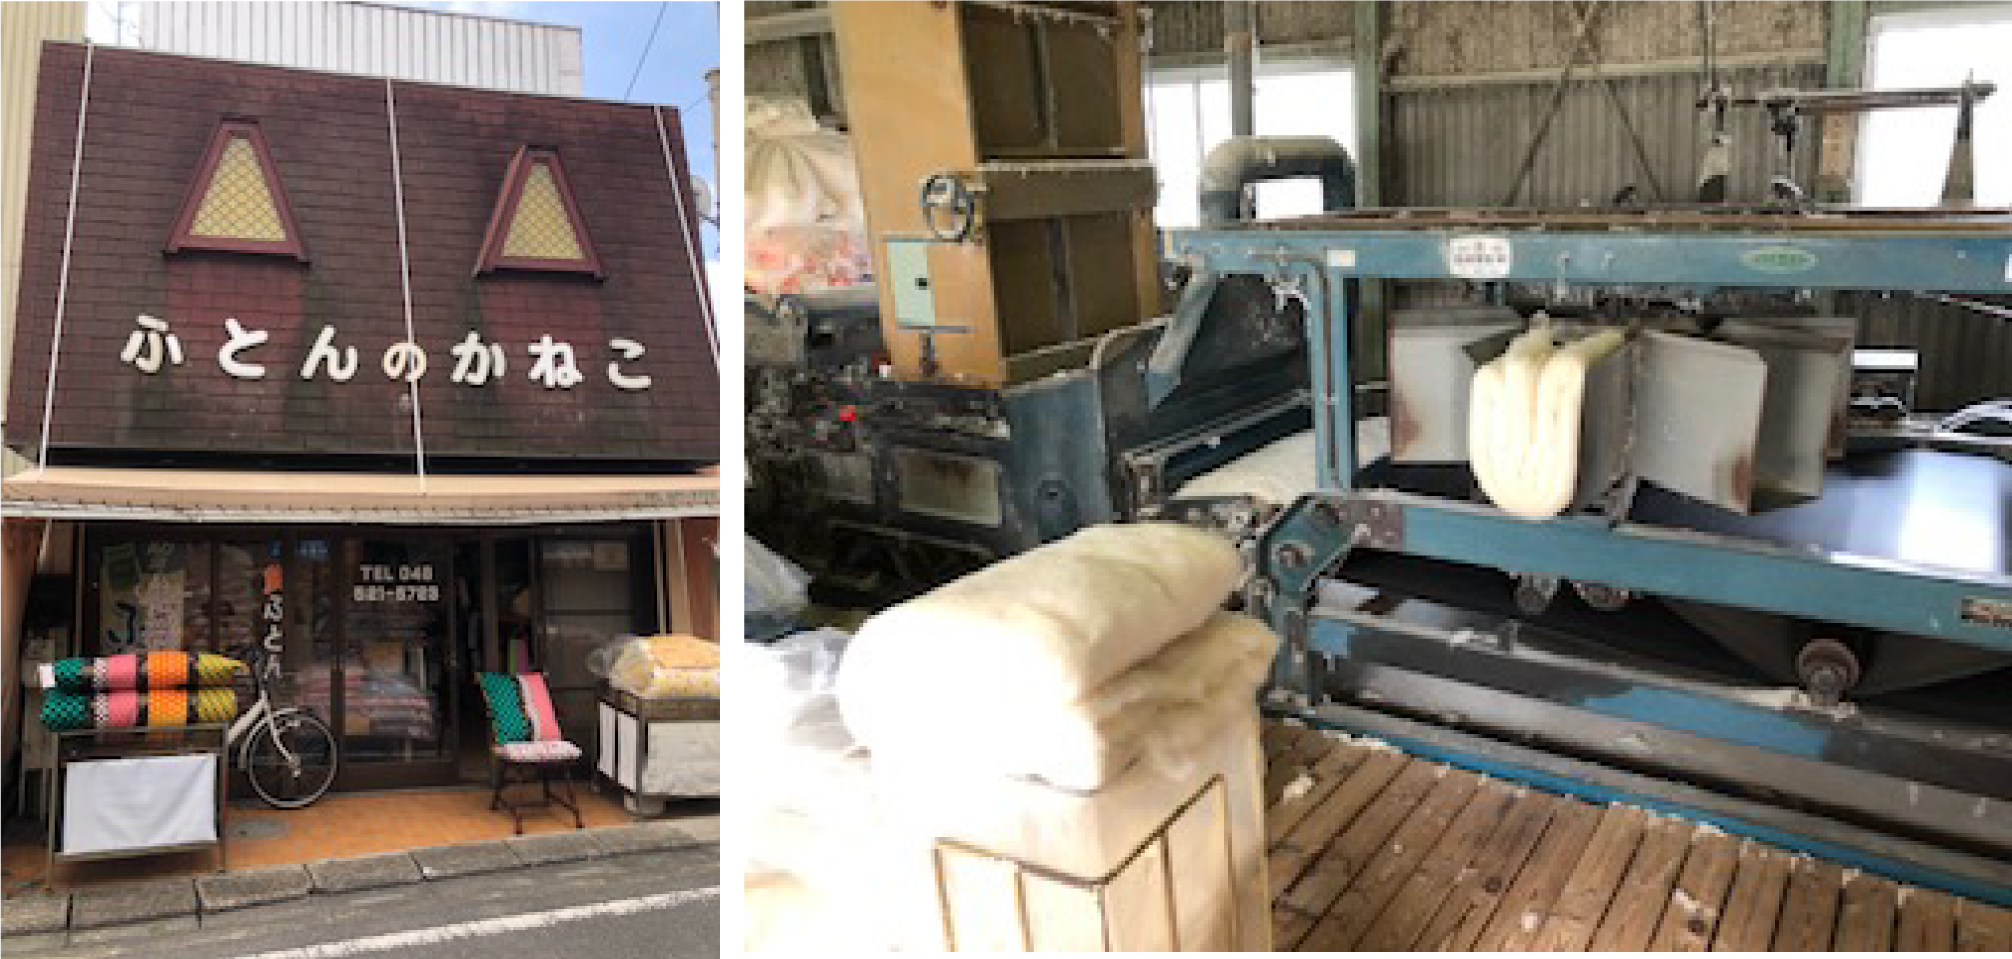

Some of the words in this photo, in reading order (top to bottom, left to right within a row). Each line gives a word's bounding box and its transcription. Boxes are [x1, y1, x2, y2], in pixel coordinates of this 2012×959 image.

[121, 314, 652, 389] ふとんのかねこ
[360, 564, 394, 581] TEL
[399, 564, 433, 581] 048
